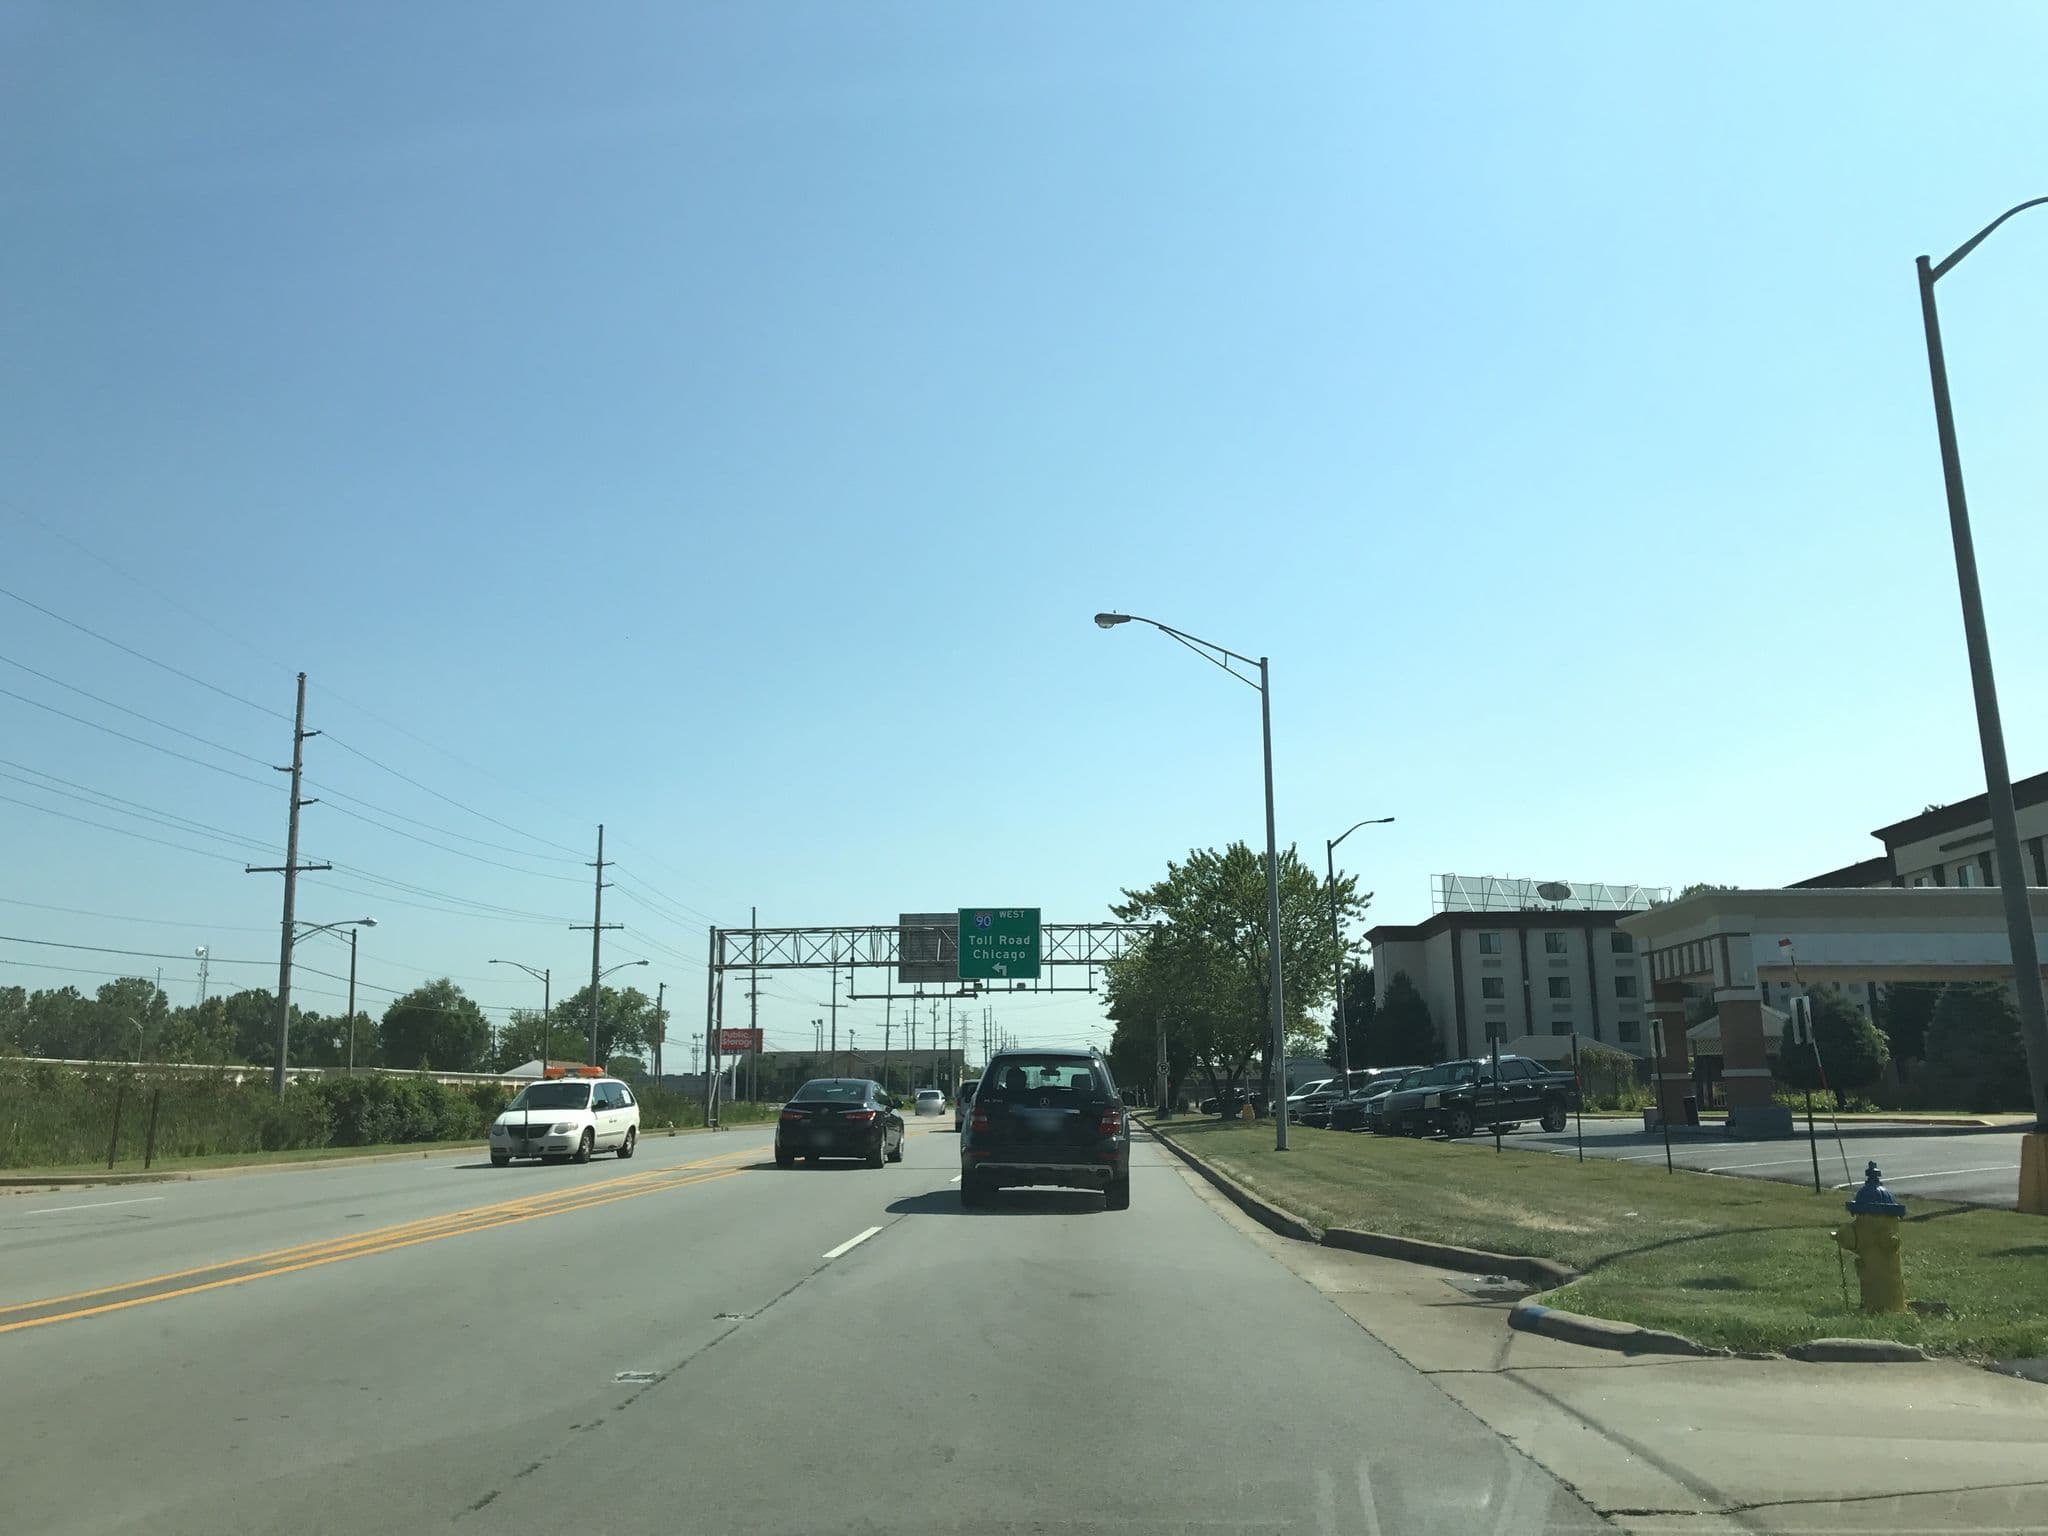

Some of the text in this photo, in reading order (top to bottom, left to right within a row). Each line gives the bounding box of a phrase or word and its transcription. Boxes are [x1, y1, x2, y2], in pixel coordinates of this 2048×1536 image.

[999, 910, 1024, 918] WEST
[976, 915, 992, 927] 90
[969, 935, 1030, 945] Toll Road
[973, 949, 1026, 962] Chicago
[722, 1030, 750, 1039] Public
